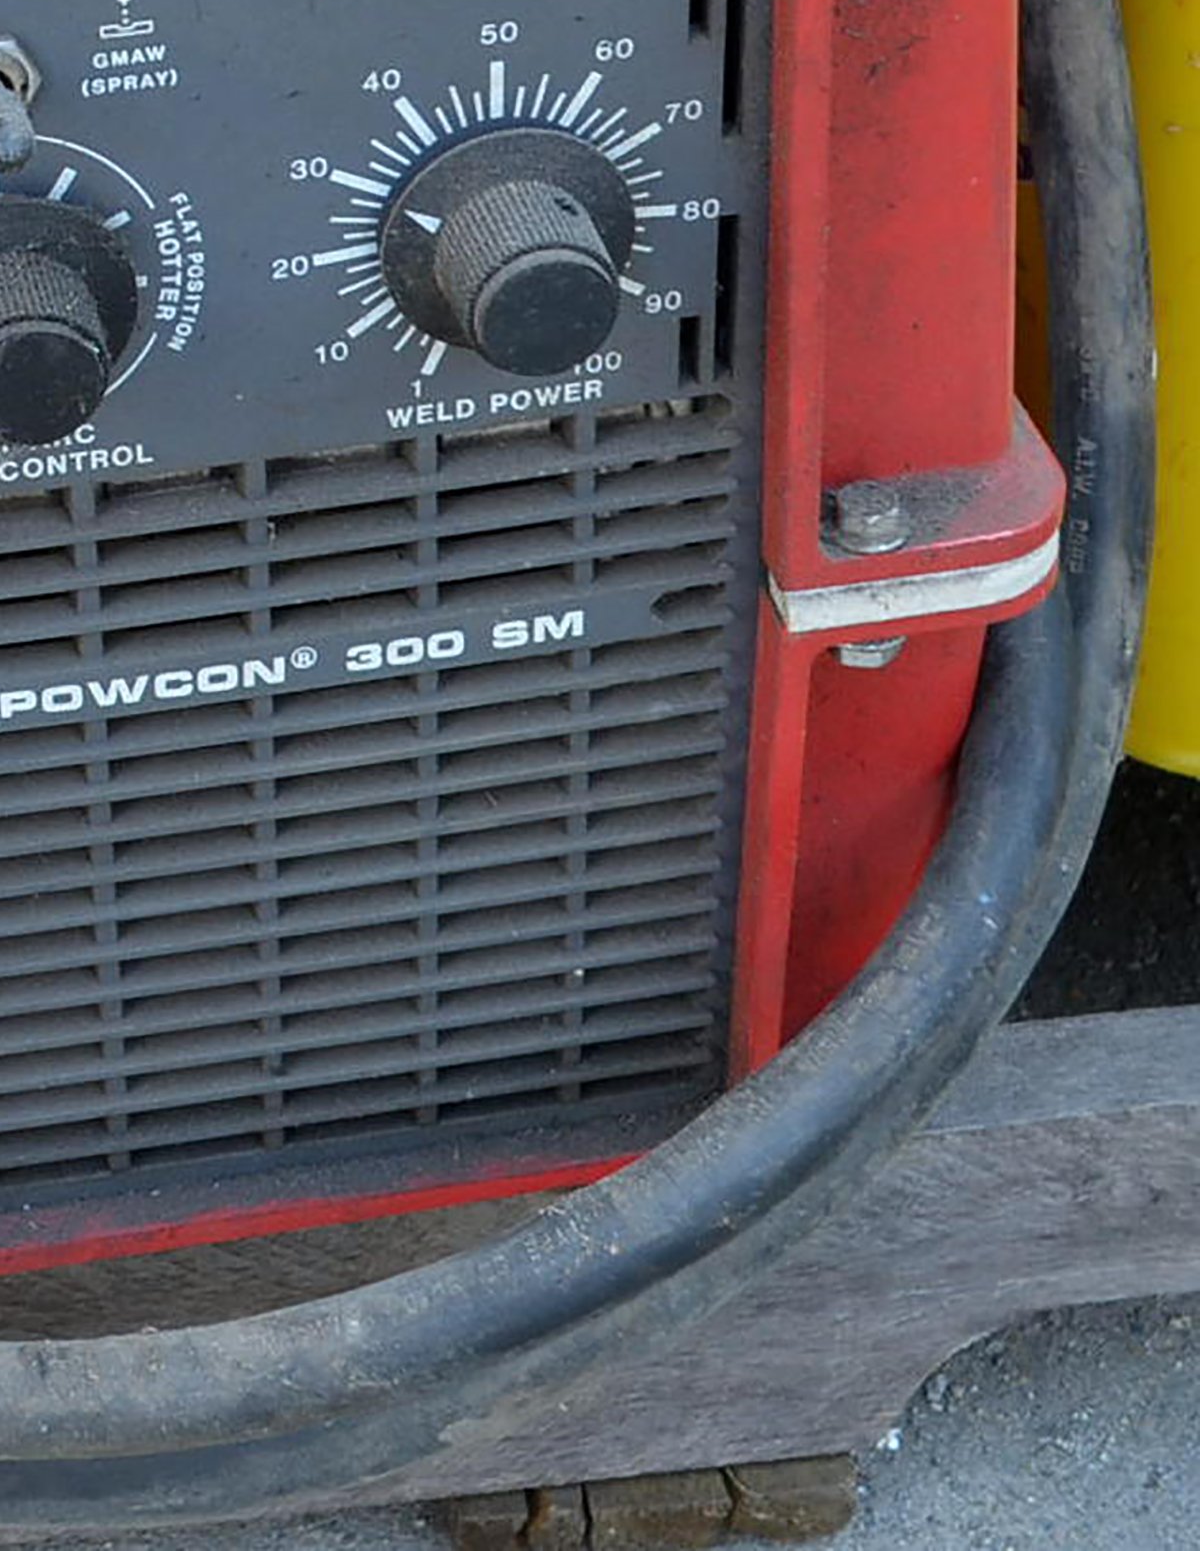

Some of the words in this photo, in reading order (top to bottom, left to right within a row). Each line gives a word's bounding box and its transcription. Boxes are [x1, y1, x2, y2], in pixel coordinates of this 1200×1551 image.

[480, 21, 519, 46] 50
[92, 44, 168, 71] GMAW
[595, 37, 635, 62] 60
[81, 68, 178, 98] (SPRAY)
[361, 68, 402, 93] 40
[664, 99, 703, 124] 70
[289, 156, 329, 181] 30
[168, 192, 203, 243] FLAT
[682, 197, 721, 222] 80
[153, 219, 183, 322] HOTTER
[271, 255, 310, 280] 20
[166, 251, 205, 352] POSITION
[644, 290, 682, 314] 90
[314, 341, 349, 365] 10
[411, 380, 422, 399] 1
[386, 398, 476, 429] WELD
[490, 379, 604, 414] POWER
[345, 630, 465, 672] 300
[492, 610, 585, 649] SM
